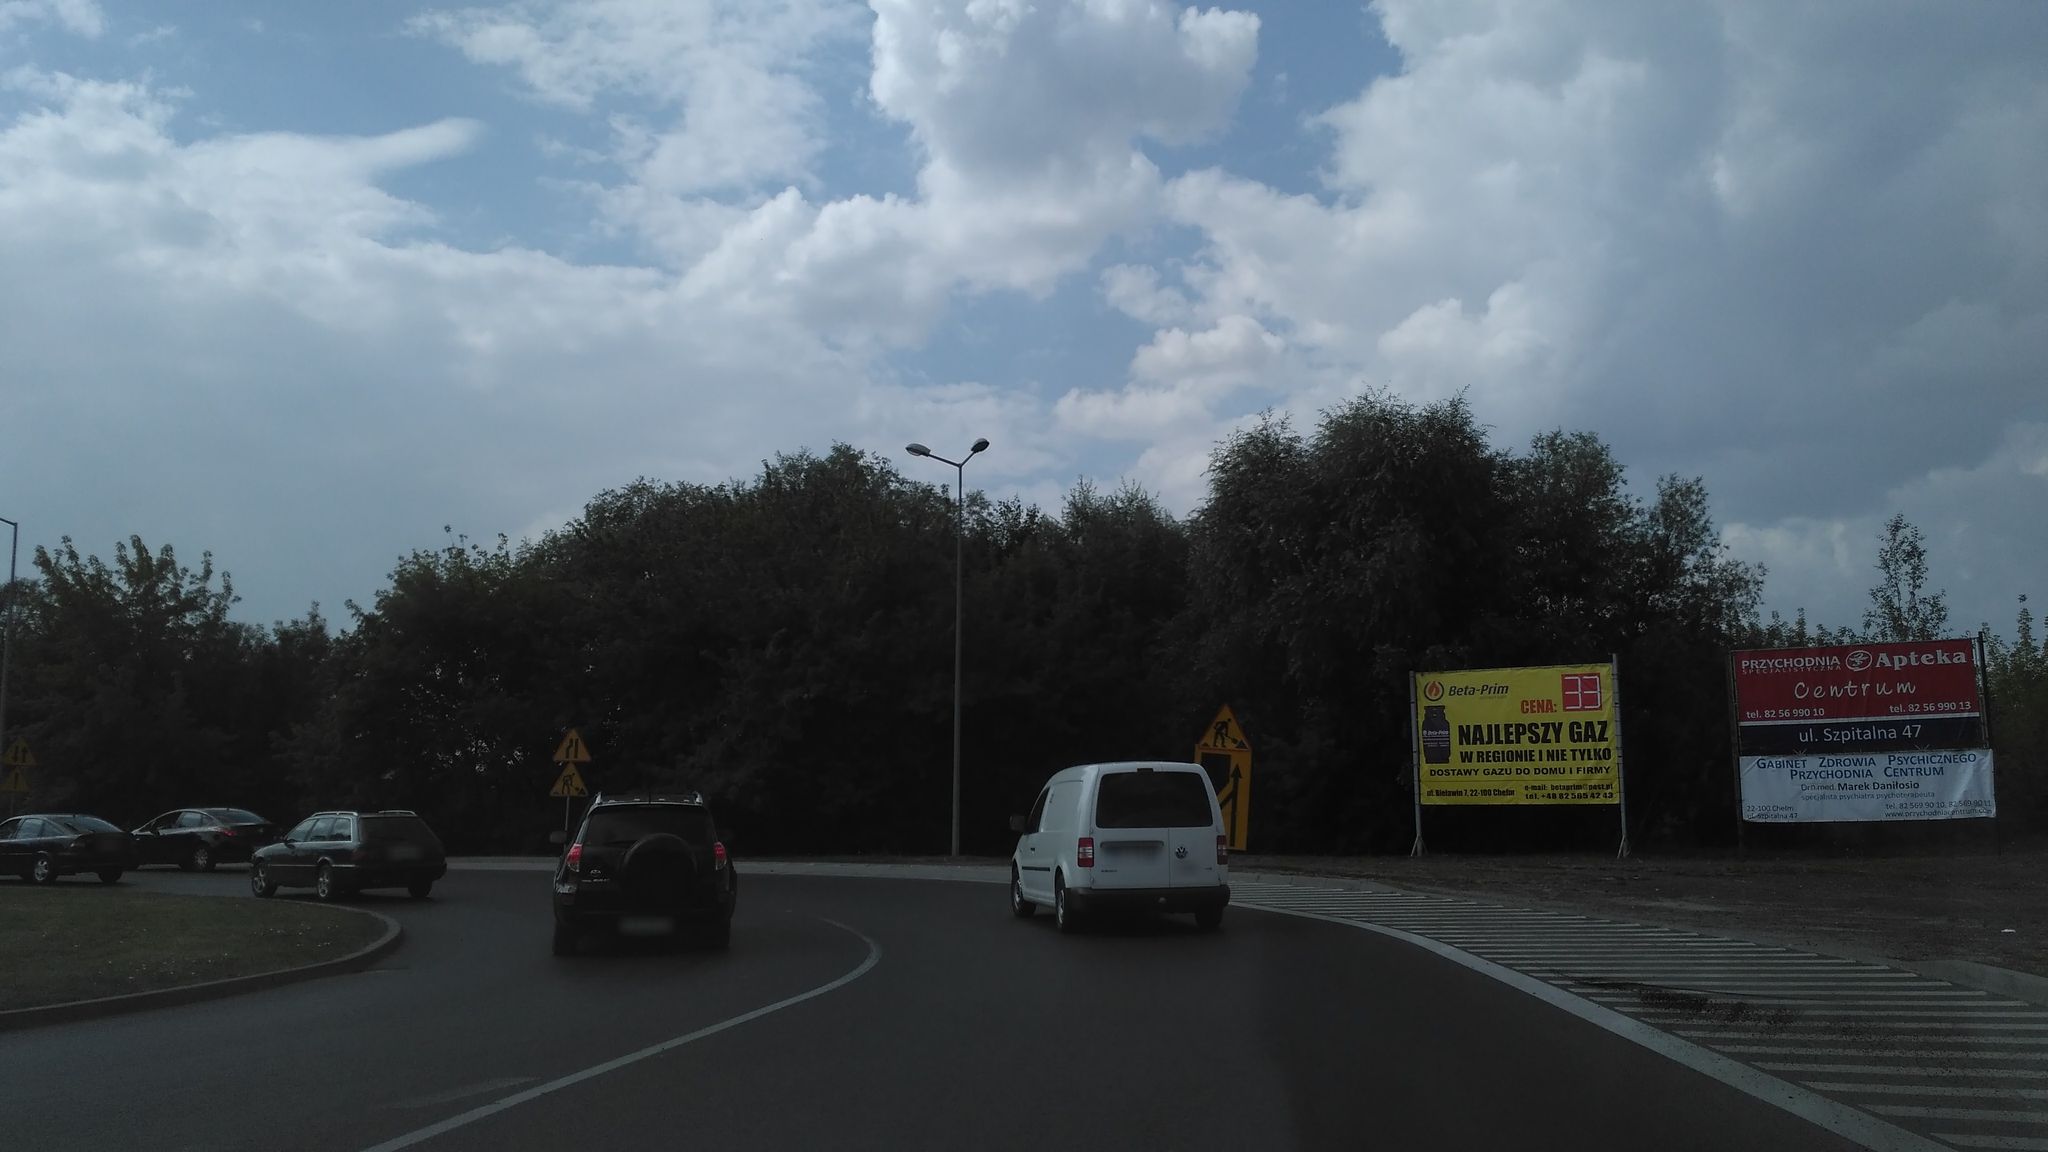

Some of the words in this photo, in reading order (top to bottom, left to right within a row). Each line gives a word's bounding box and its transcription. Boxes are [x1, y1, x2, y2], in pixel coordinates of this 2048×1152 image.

[1741, 656, 1840, 669] PRZYCHODNIA
[1875, 649, 1967, 671] Apteka
[1448, 683, 1509, 696] Beta-Prim
[1794, 681, 1916, 699] Centrum
[1520, 699, 1557, 714] CENA:
[1889, 704, 1906, 713] tel.
[1908, 704, 1920, 712] 82
[1923, 703, 1935, 711] 56
[1937, 702, 1956, 711] 990
[1958, 701, 1971, 710] 13
[1746, 709, 1761, 719] tel.
[1764, 710, 1776, 718] 82
[1778, 709, 1790, 717] 56
[1792, 709, 1810, 717] 990
[1813, 708, 1825, 716] 10
[1458, 722, 1563, 745] NAJLEPSZY
[1569, 720, 1608, 743] GAZ
[1799, 728, 1818, 742] ul.
[1823, 725, 1897, 744] Szpitalna
[1902, 725, 1921, 738] 47
[1459, 751, 1473, 763] W
[1476, 750, 1535, 763] REGIONIE
[1539, 750, 1543, 761] I
[1547, 749, 1567, 761] NIE
[1570, 748, 1612, 761] TYLKO
[1757, 758, 1807, 768] GABINET
[1819, 756, 1876, 767] ZDROWIA
[1888, 753, 1976, 765] PSYCHICZNEGO
[1483, 768, 1512, 776] GAZU
[1534, 767, 1566, 775] DOMU
[1576, 766, 1610, 774] FIRMY
[1790, 768, 1873, 780] PRZYCHODNIA
[1884, 766, 1944, 777] CENTRUM
[1470, 788, 1492, 796] 22-100
[1838, 782, 1870, 791] Marek
[1873, 780, 1920, 790] Daniłosio
[1876, 791, 1935, 800] psychoterapeuta
